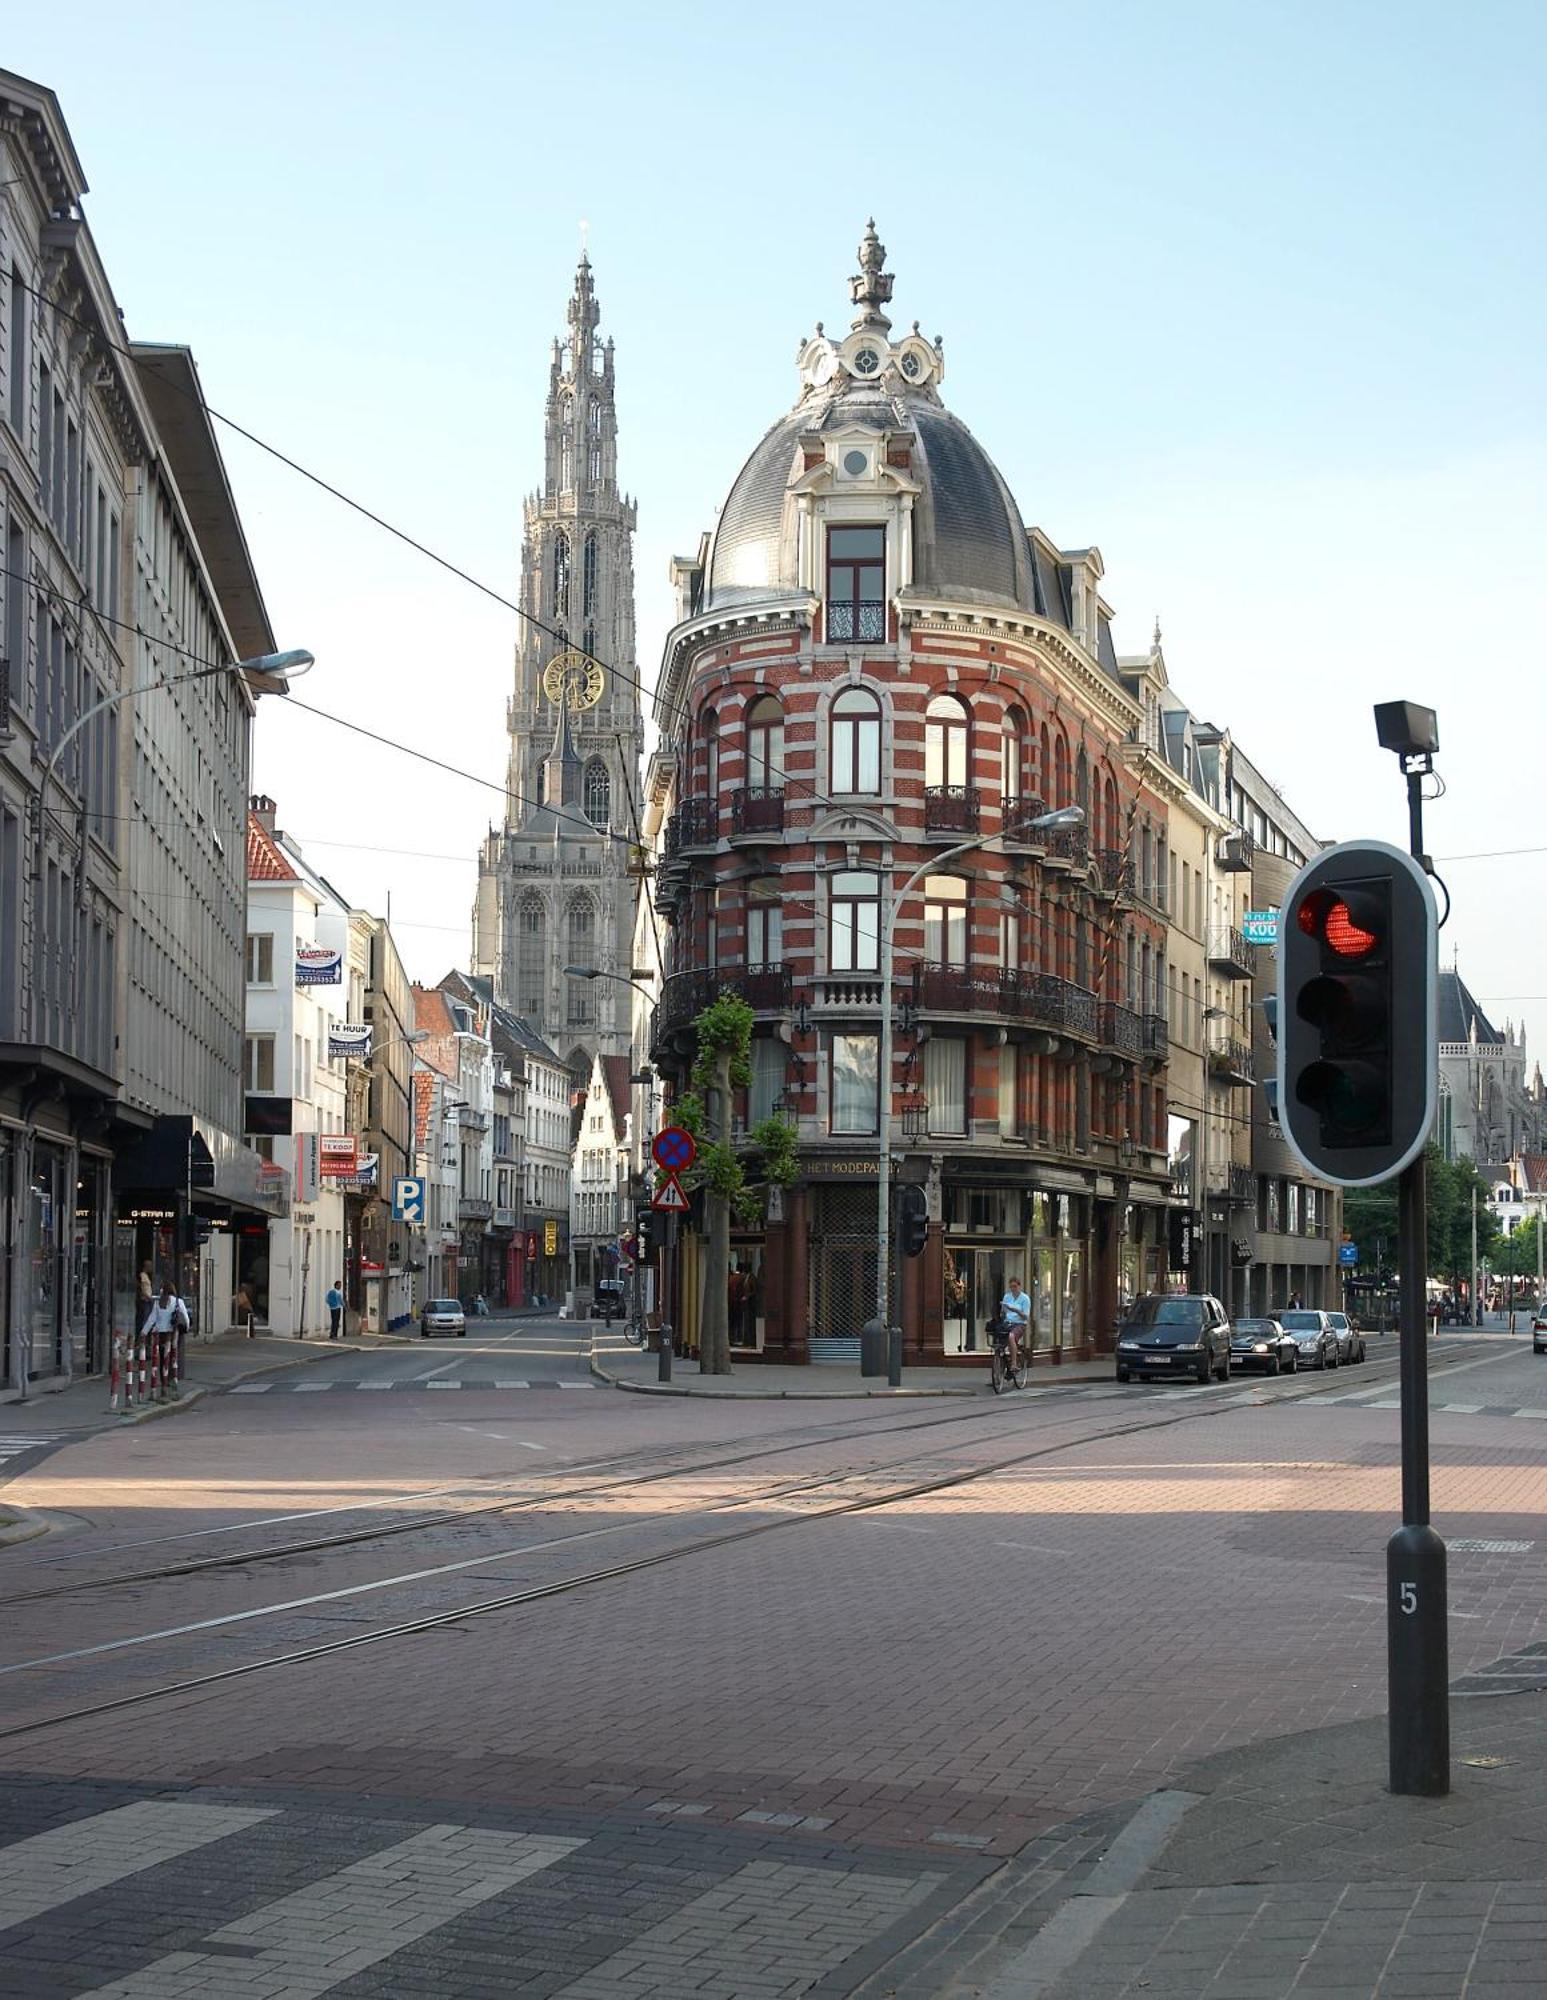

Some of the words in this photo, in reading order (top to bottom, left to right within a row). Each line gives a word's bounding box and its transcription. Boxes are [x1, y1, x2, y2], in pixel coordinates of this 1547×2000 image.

[1249, 924, 1276, 936] KOO
[331, 1024, 341, 1032] TE
[343, 1025, 368, 1033] HUUR
[807, 1161, 829, 1174] HET
[396, 1180, 420, 1209] P
[1400, 1581, 1417, 1615] 5
